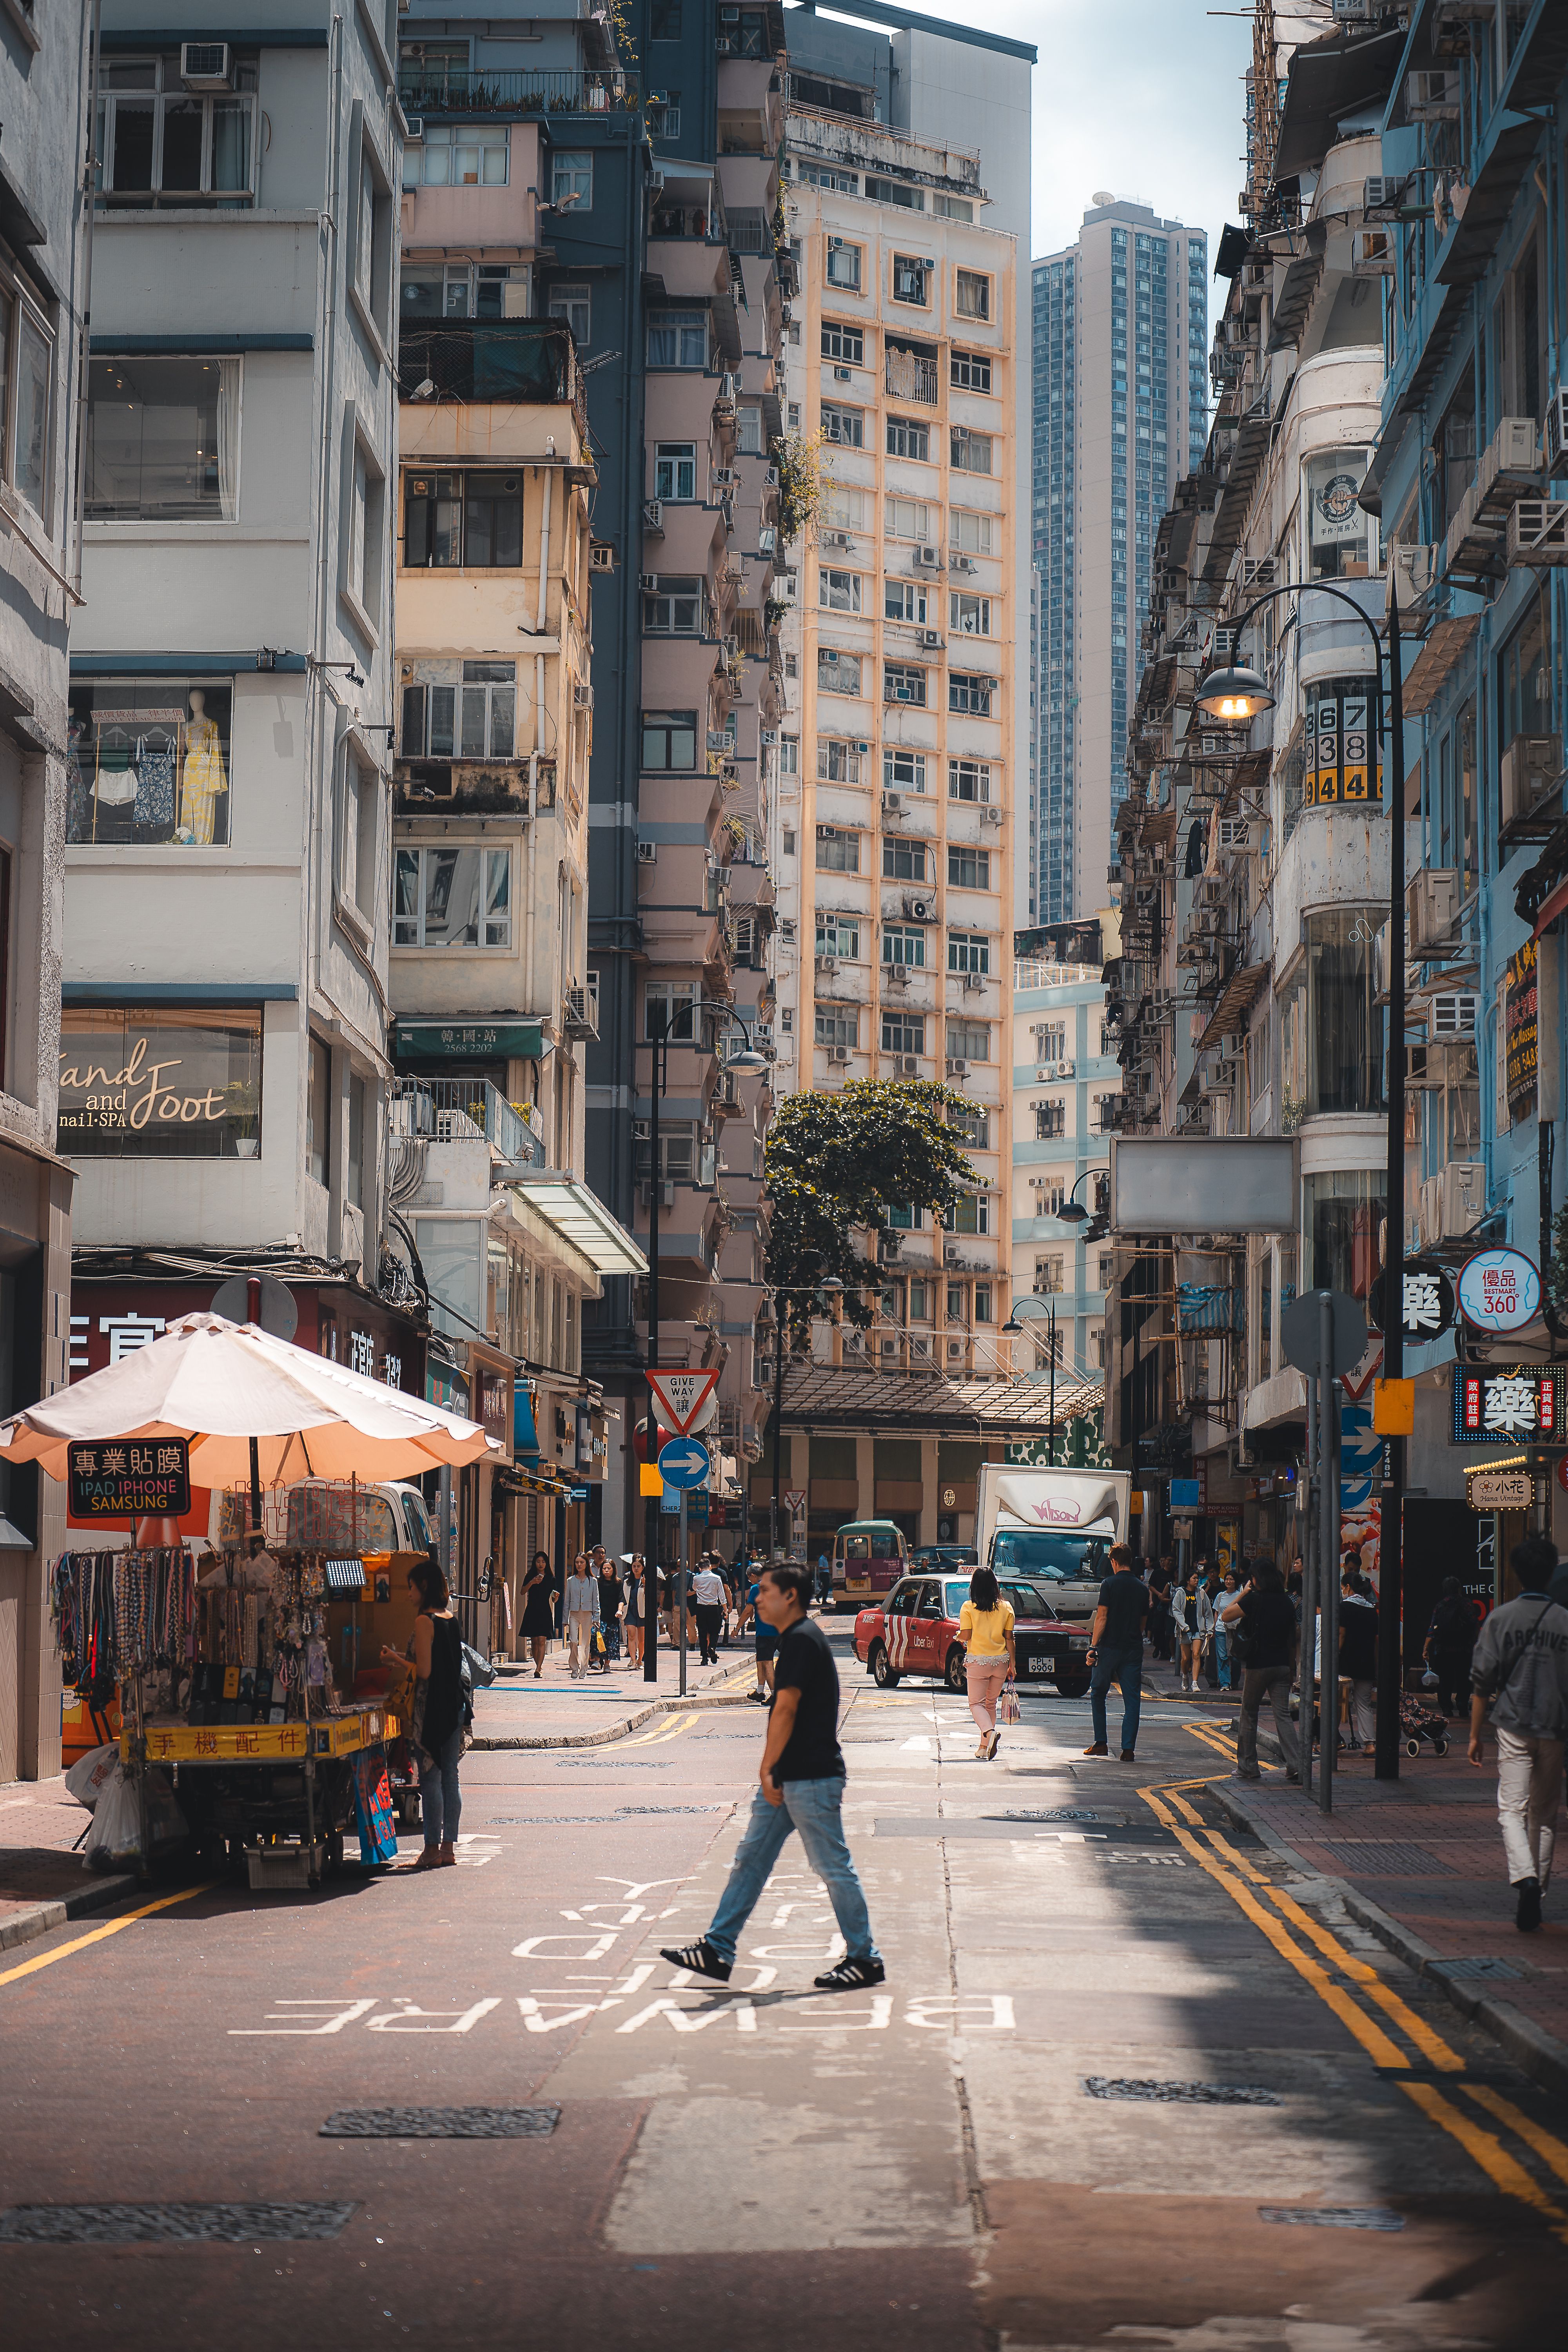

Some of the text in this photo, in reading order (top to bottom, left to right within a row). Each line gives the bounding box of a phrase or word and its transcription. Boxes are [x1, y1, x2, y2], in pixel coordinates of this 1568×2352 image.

[1328, 510, 1352, 521] WORKSHOP
[91, 709, 184, 718] 減價貨品一律半價
[445, 1044, 466, 1053] 2568
[60, 1038, 147, 1088] and
[85, 1089, 127, 1111] and
[130, 1060, 227, 1129] Foot
[1482, 1270, 1516, 1287] 優品
[670, 1377, 695, 1386] GIVE
[676, 1399, 689, 1412] 讓
[1468, 1381, 1478, 1426] 政府註冊
[1483, 1377, 1536, 1430] 藥
[74, 1446, 183, 1477] 專業貼膜
[81, 1479, 177, 1495] IPAD IPHONE
[1495, 1479, 1524, 1494] 小花
[91, 1495, 167, 1510] SAMSUNG
[1463, 1584, 1485, 1594] THE
[914, 1635, 934, 1648] Uber Taxi
[153, 1729, 301, 1755] 手機配件
[227, 1995, 1016, 2035] BEWARE
